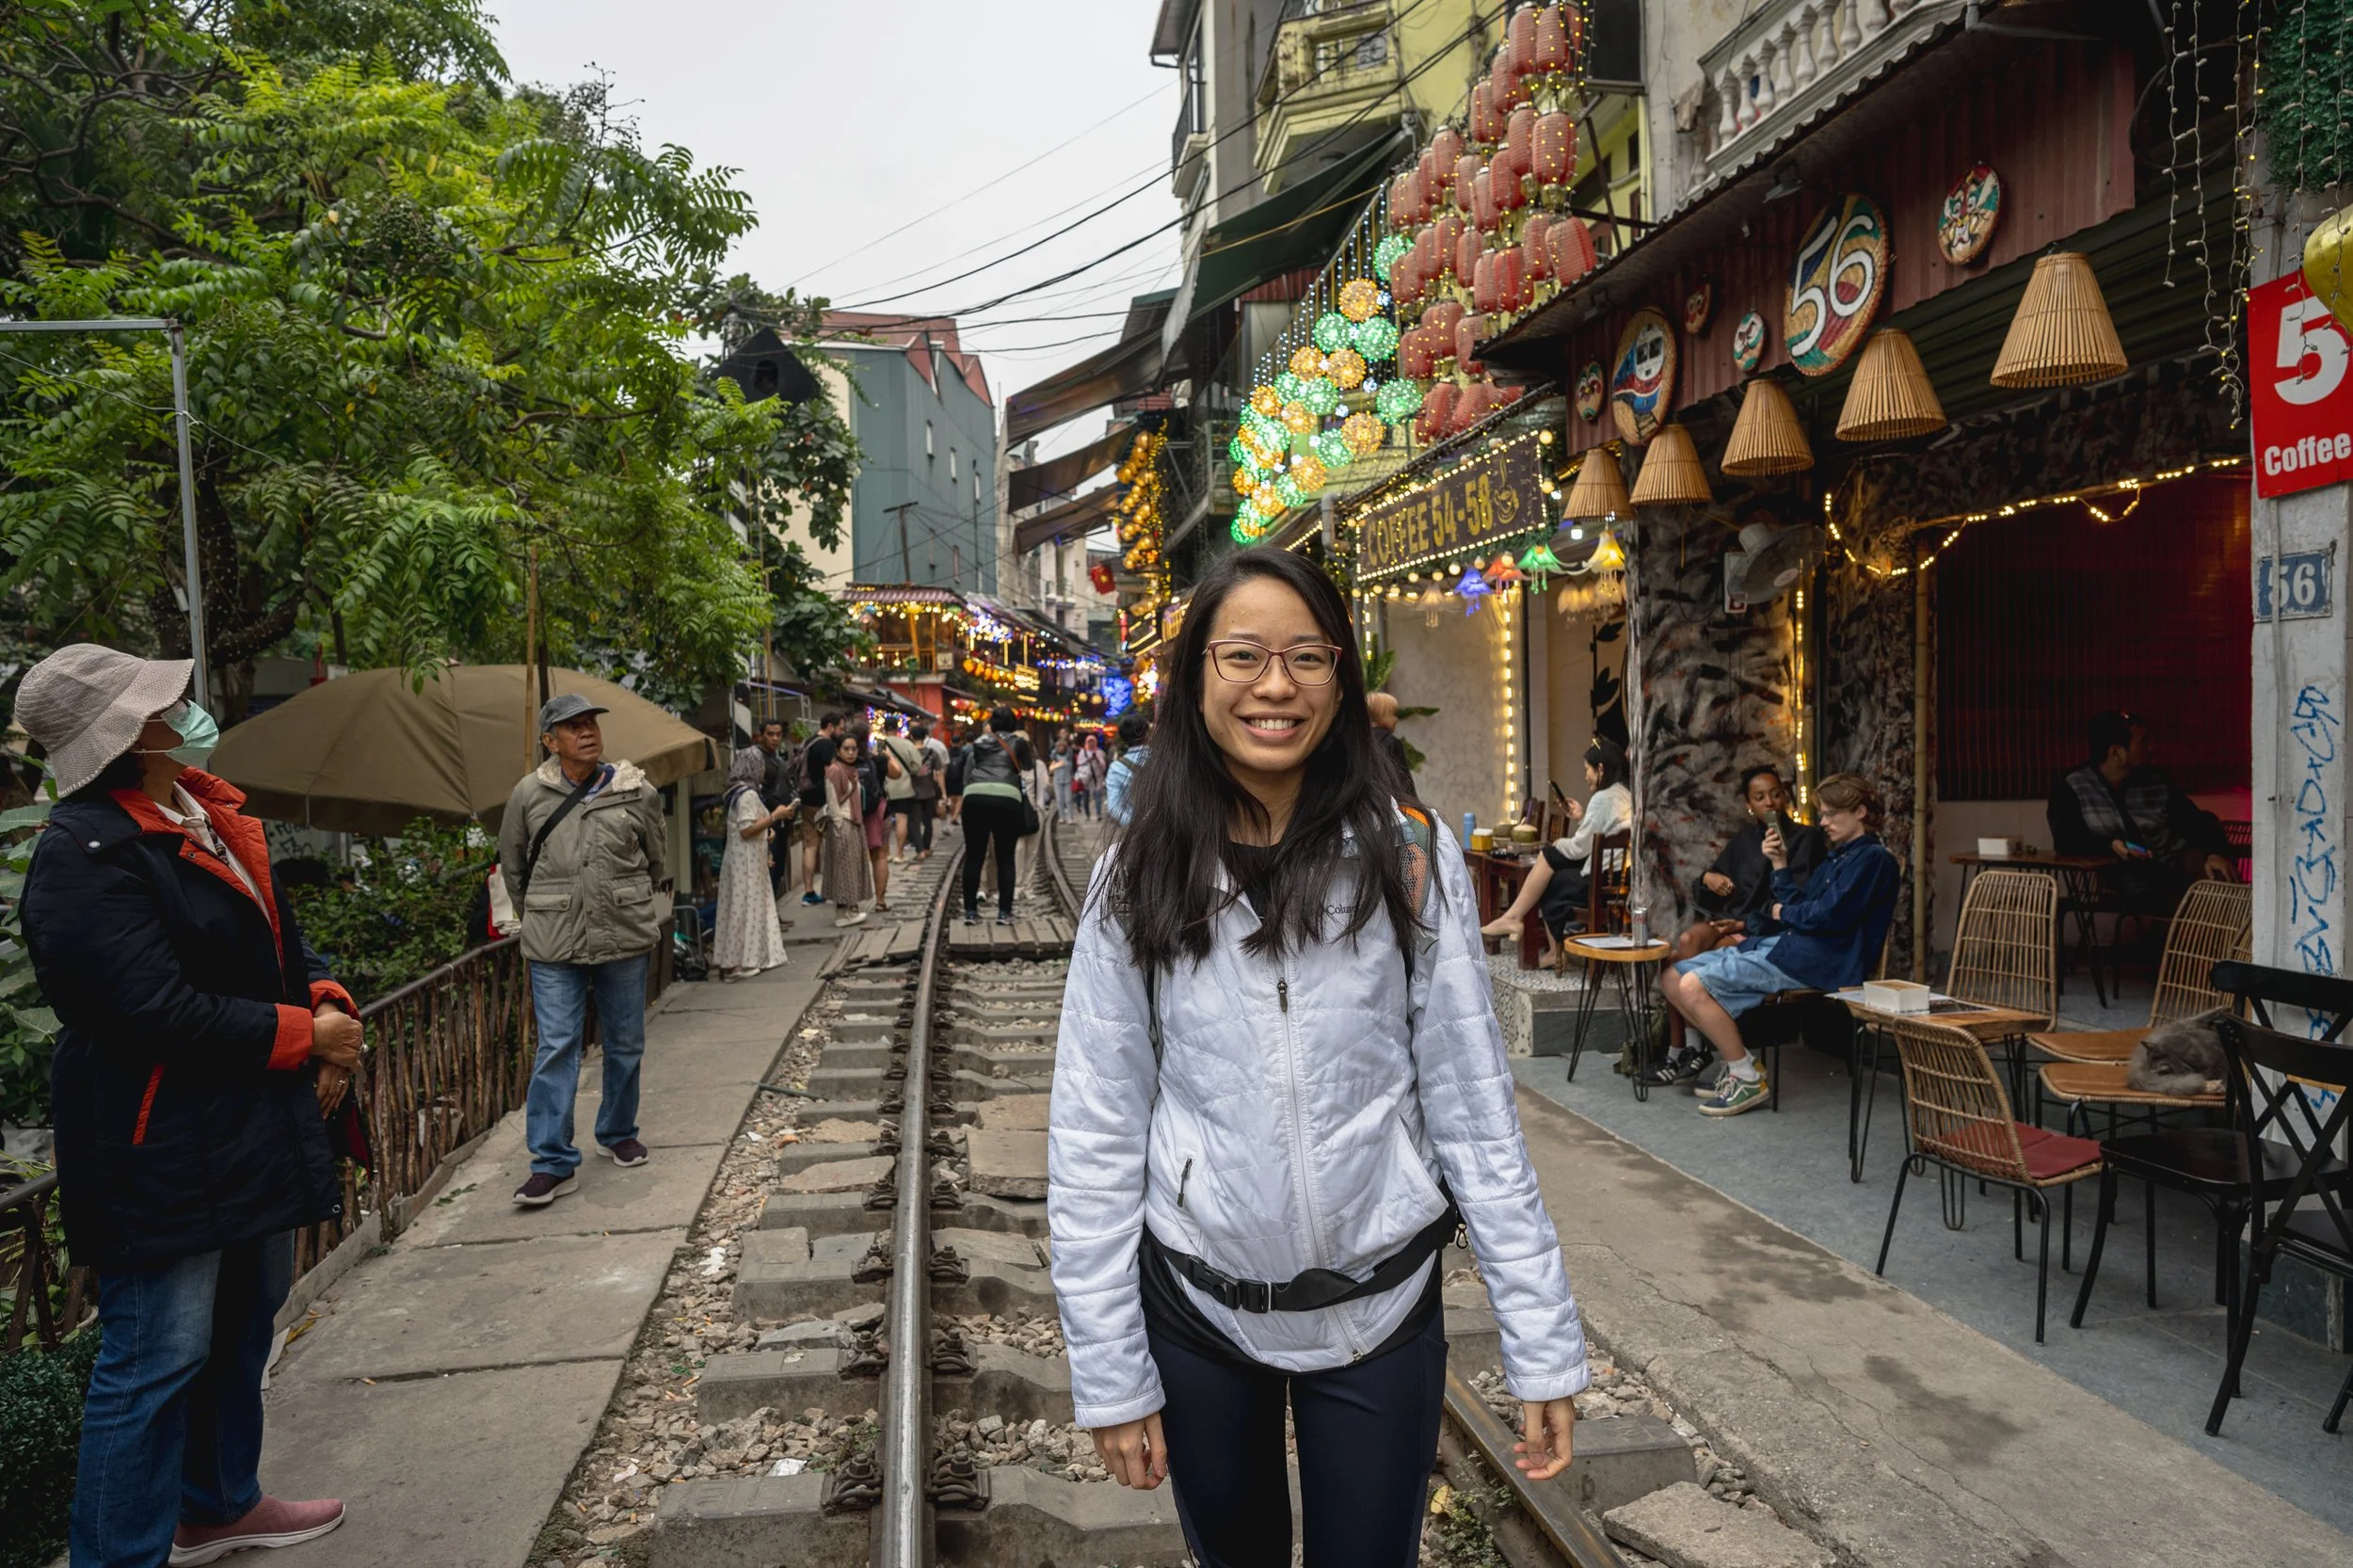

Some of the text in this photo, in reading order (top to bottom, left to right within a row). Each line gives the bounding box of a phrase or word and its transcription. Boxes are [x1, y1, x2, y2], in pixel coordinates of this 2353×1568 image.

[1791, 215, 1874, 356] 56
[2264, 433, 2351, 475] Coffee
[1368, 473, 1495, 566] COFFEE 54-58
[2267, 563, 2315, 607] 56
